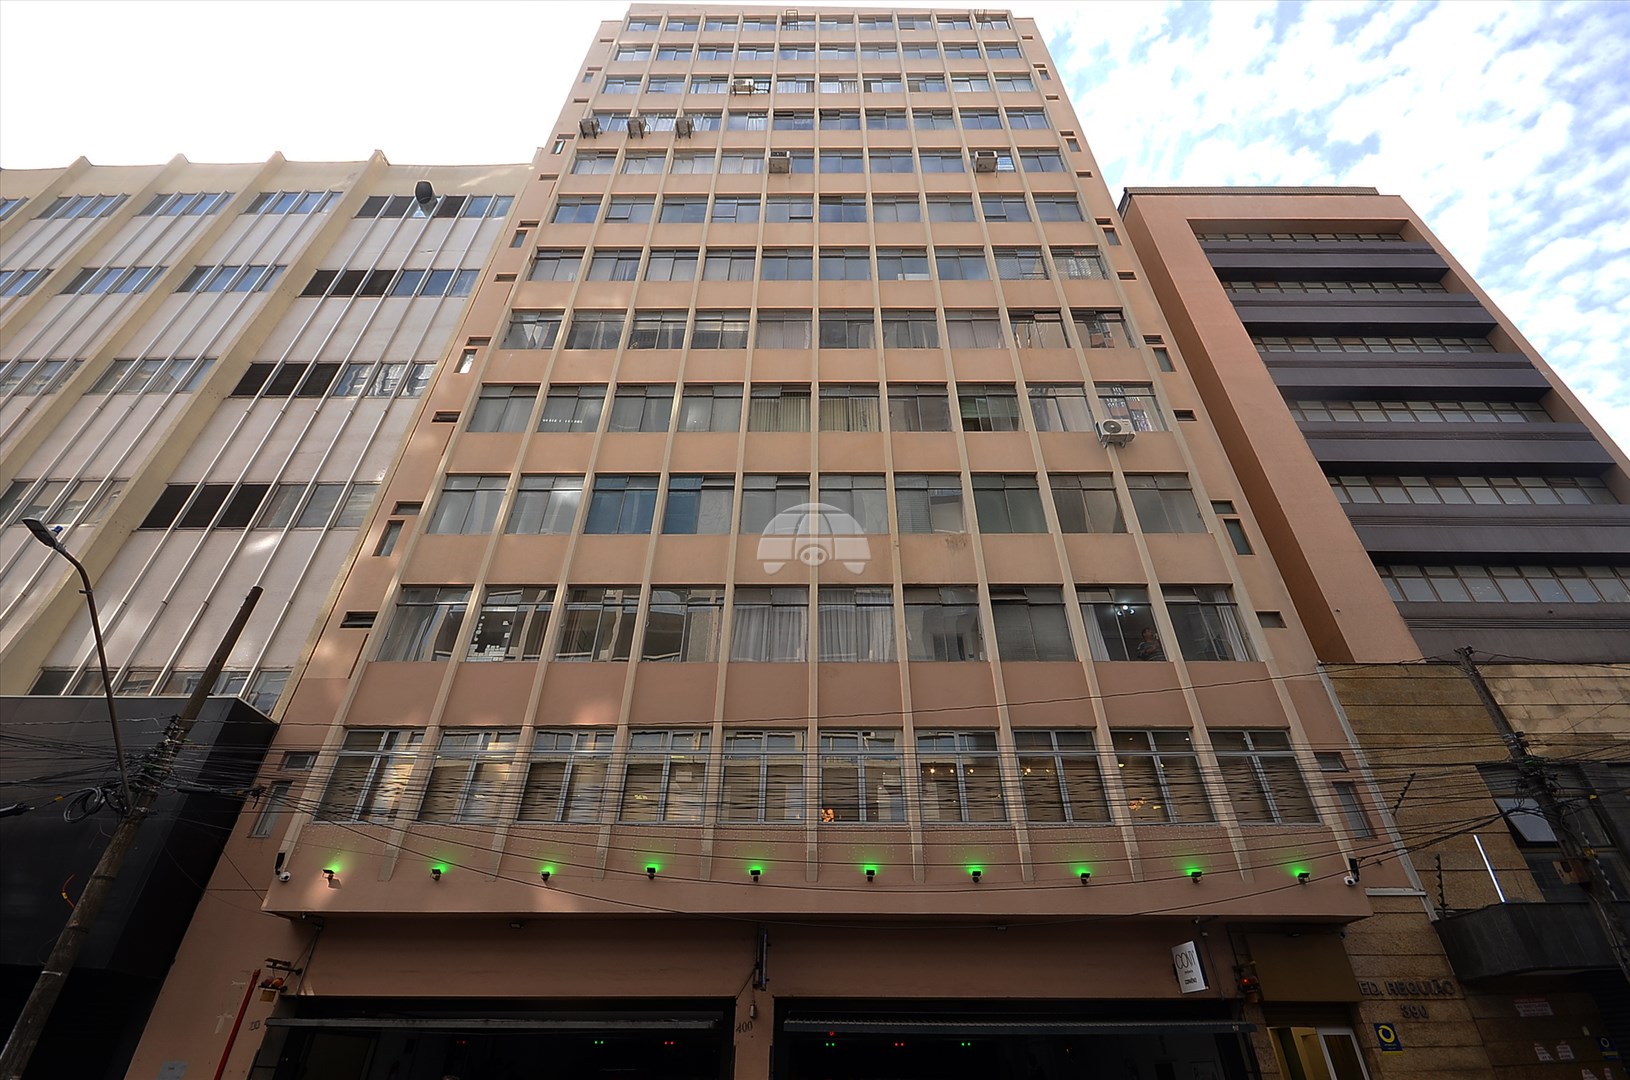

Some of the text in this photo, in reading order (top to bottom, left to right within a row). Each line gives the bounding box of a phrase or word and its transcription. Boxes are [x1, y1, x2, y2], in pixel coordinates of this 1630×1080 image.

[1384, 976, 1456, 996] REQUIÃO
[1400, 1004, 1429, 1019] 390
[735, 1020, 753, 1034] 400
